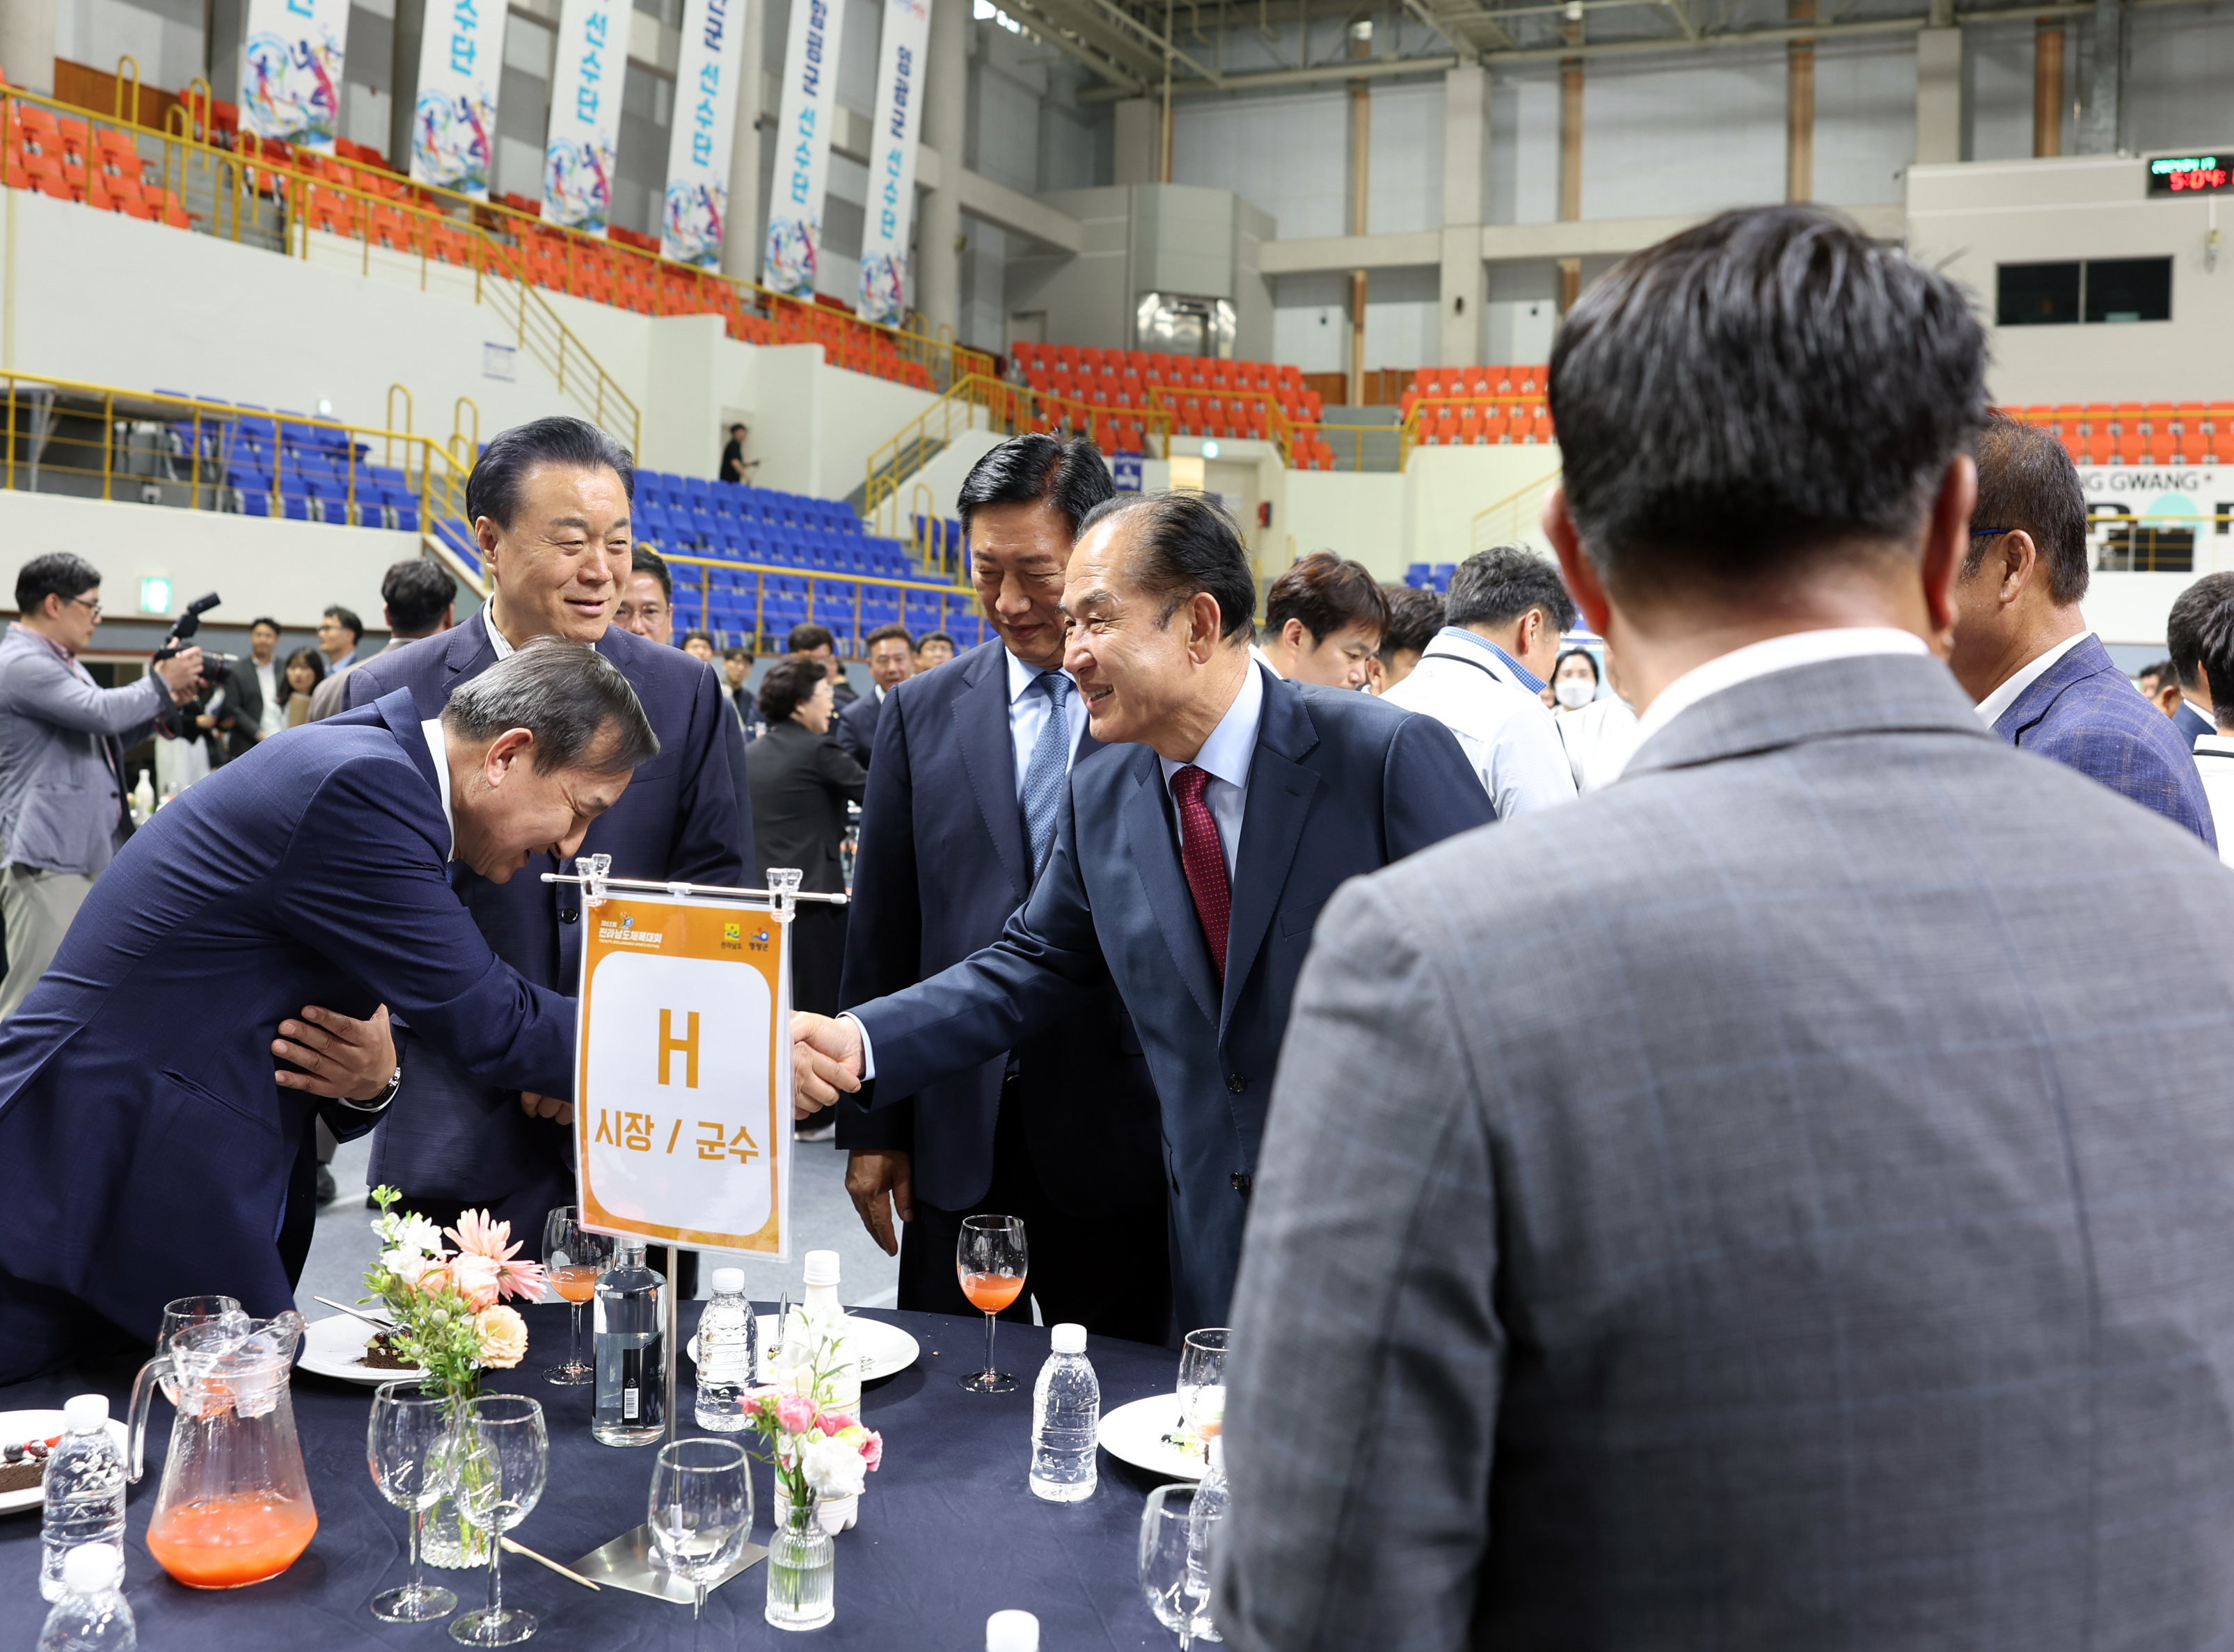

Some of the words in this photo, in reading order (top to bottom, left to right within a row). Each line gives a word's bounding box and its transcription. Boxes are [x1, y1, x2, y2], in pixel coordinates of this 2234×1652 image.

[577, 12, 608, 125] 선수단
[692, 63, 720, 168] 선수단
[791, 107, 816, 205] 선수단
[881, 148, 903, 239] 선수단
[2109, 471, 2199, 491] GWANG
[658, 1008, 699, 1089] H
[595, 1109, 654, 1152] 시장
[666, 1119, 682, 1154] /
[697, 1121, 759, 1164] 군수
